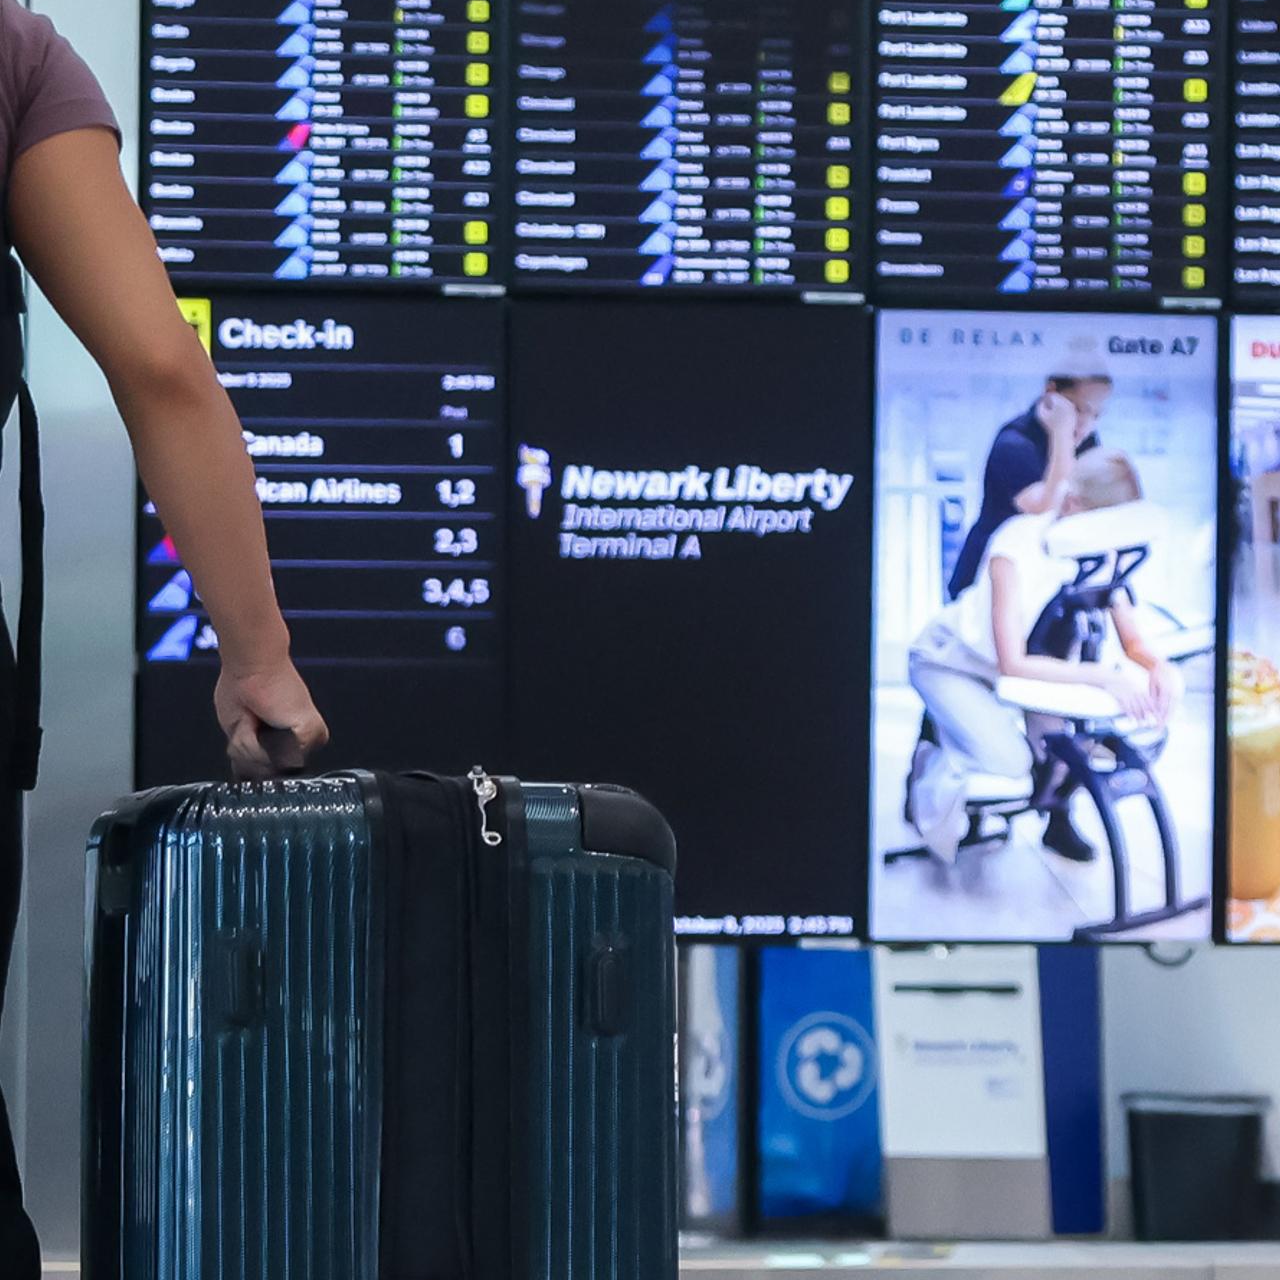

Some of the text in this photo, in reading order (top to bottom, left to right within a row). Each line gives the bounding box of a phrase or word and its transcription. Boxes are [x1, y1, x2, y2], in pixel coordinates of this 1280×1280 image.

[218, 318, 354, 350] Check-in
[899, 328, 1044, 346] BE RELAX
[1107, 335, 1200, 355] Gate A7
[447, 433, 464, 458] 1
[309, 478, 402, 504] Airlines
[560, 465, 854, 511] Newark Liberty
[560, 503, 815, 538] International Airport
[558, 532, 702, 560] Terminal A
